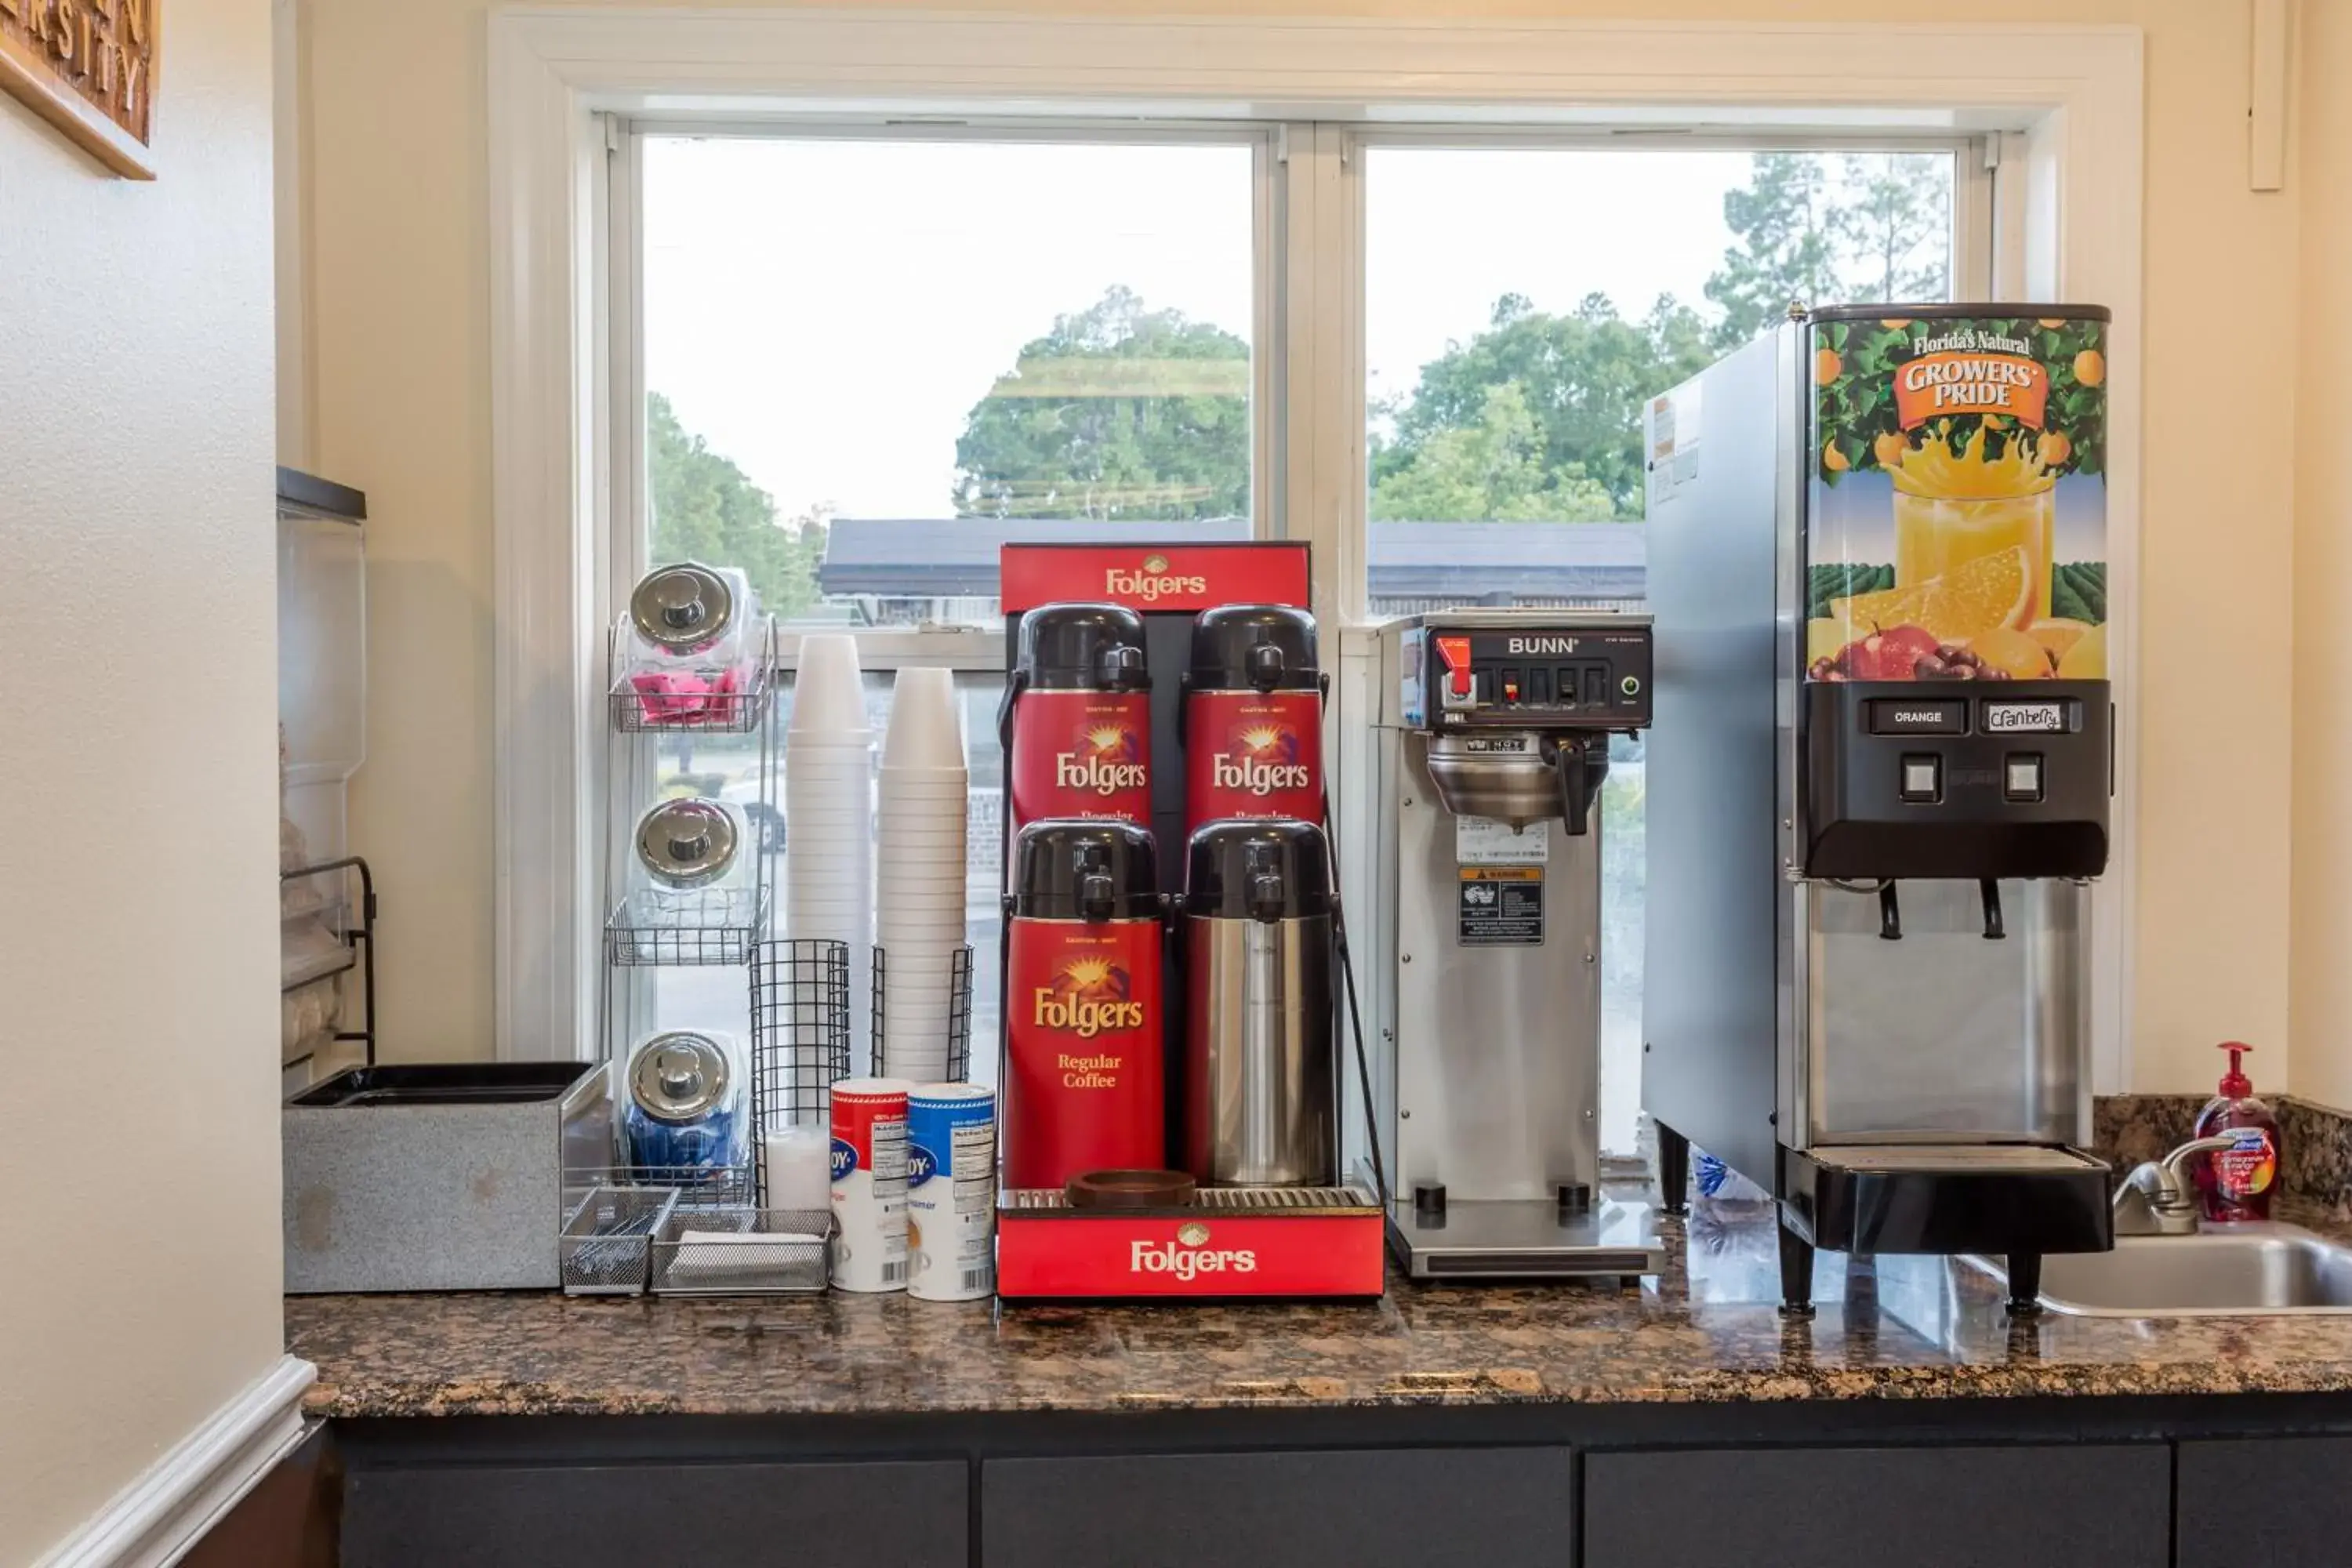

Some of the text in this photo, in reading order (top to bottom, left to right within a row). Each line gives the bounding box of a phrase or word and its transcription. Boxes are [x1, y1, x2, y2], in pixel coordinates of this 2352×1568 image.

[1913, 327, 2031, 355] Florida's Natural
[1934, 383, 2012, 407] PRIDE
[1105, 568, 1207, 601] Folgers
[1895, 711, 1942, 723] ORANGE
[1056, 752, 1146, 796] Folgers
[1213, 753, 1309, 796] Folgers
[1033, 987, 1143, 1038] Folgers
[1058, 1054, 1122, 1072] Regular
[1063, 1073, 1116, 1087] Coffee
[1130, 1240, 1257, 1281] Folgers
